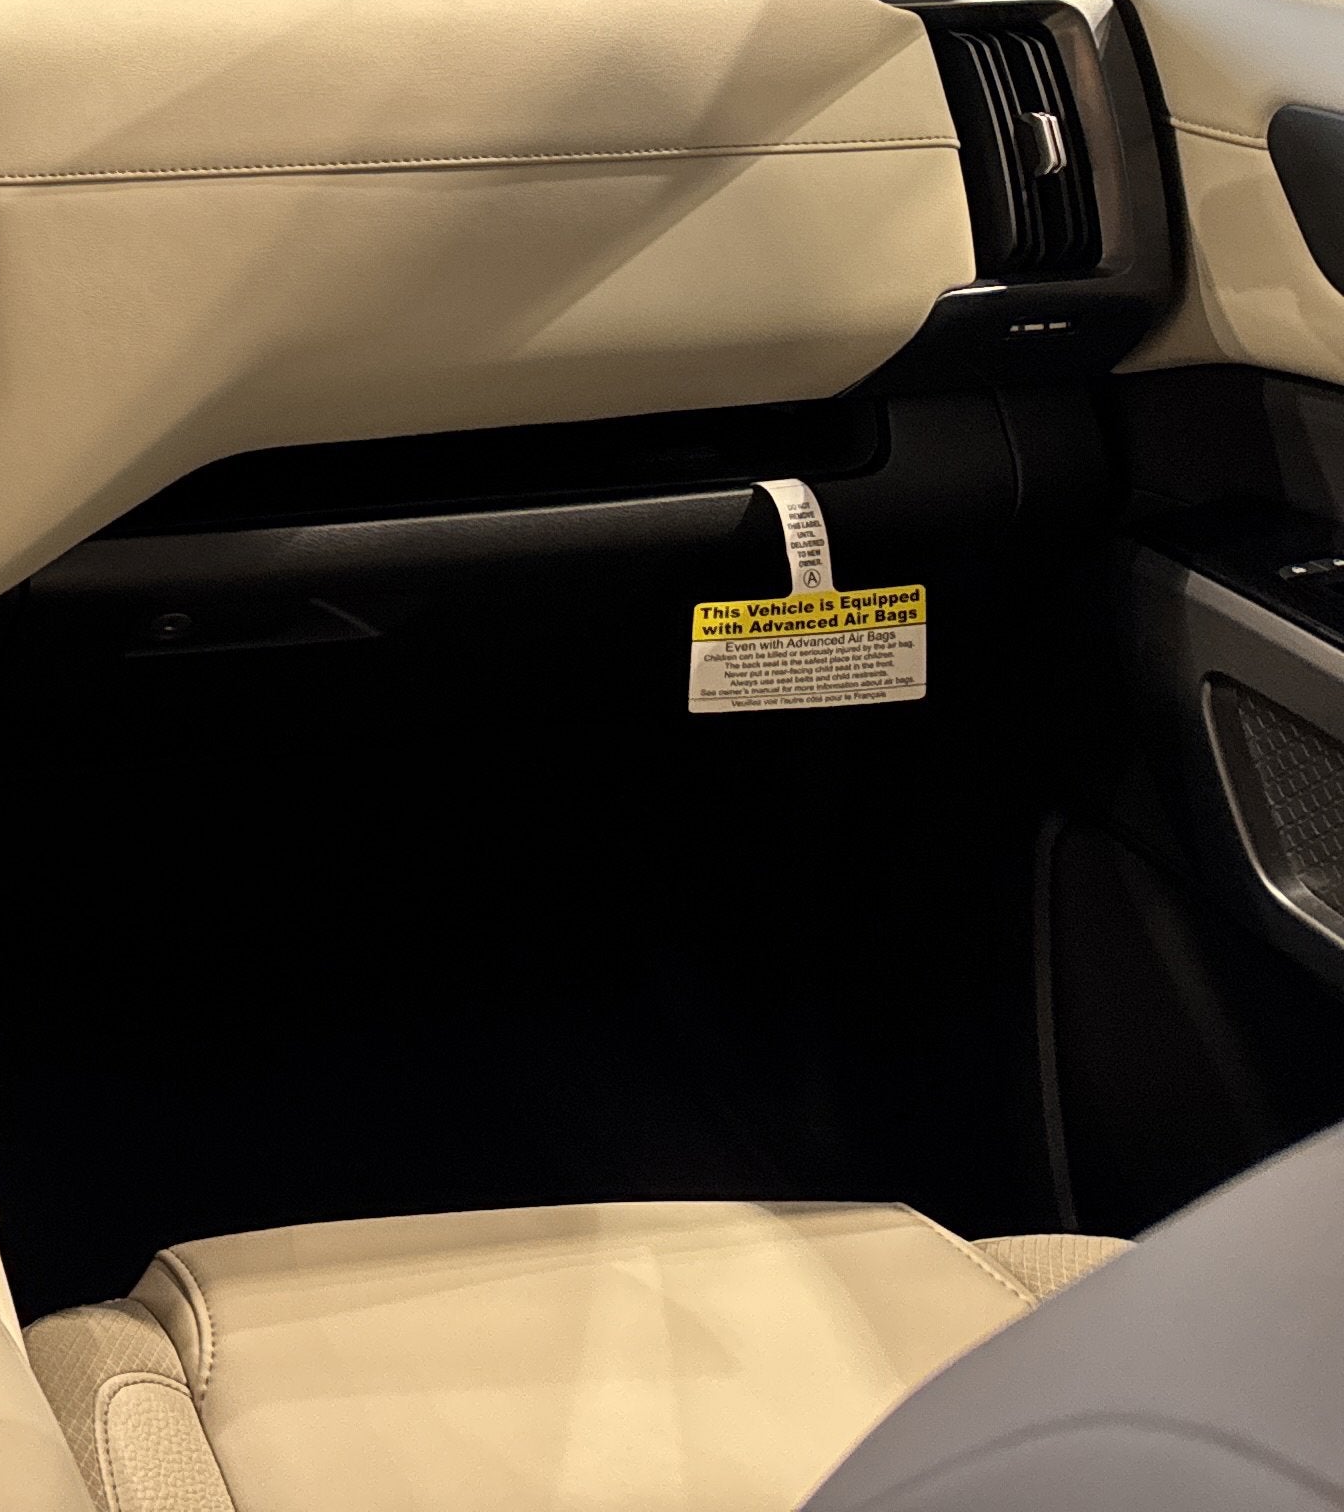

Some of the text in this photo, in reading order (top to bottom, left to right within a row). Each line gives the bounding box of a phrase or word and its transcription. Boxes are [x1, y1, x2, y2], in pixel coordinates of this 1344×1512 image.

[788, 510, 815, 520] REMOVE
[797, 530, 816, 539] UNTIL
[790, 538, 825, 549] DELIVERED
[797, 549, 821, 558] TO NEW
[700, 588, 920, 620] This Vehicle is Equipped
[701, 608, 918, 635] with Advanced Air Bags
[725, 630, 896, 653] Even with Advanced Air Bags
[703, 653, 738, 663] Children
[755, 651, 766, 659] be
[766, 650, 788, 658] killed
[835, 644, 861, 653] injured
[862, 644, 872, 652] by
[873, 642, 886, 650] the
[886, 641, 897, 649] air
[725, 662, 741, 670] The
[789, 658, 802, 666] the
[829, 656, 851, 664] place
